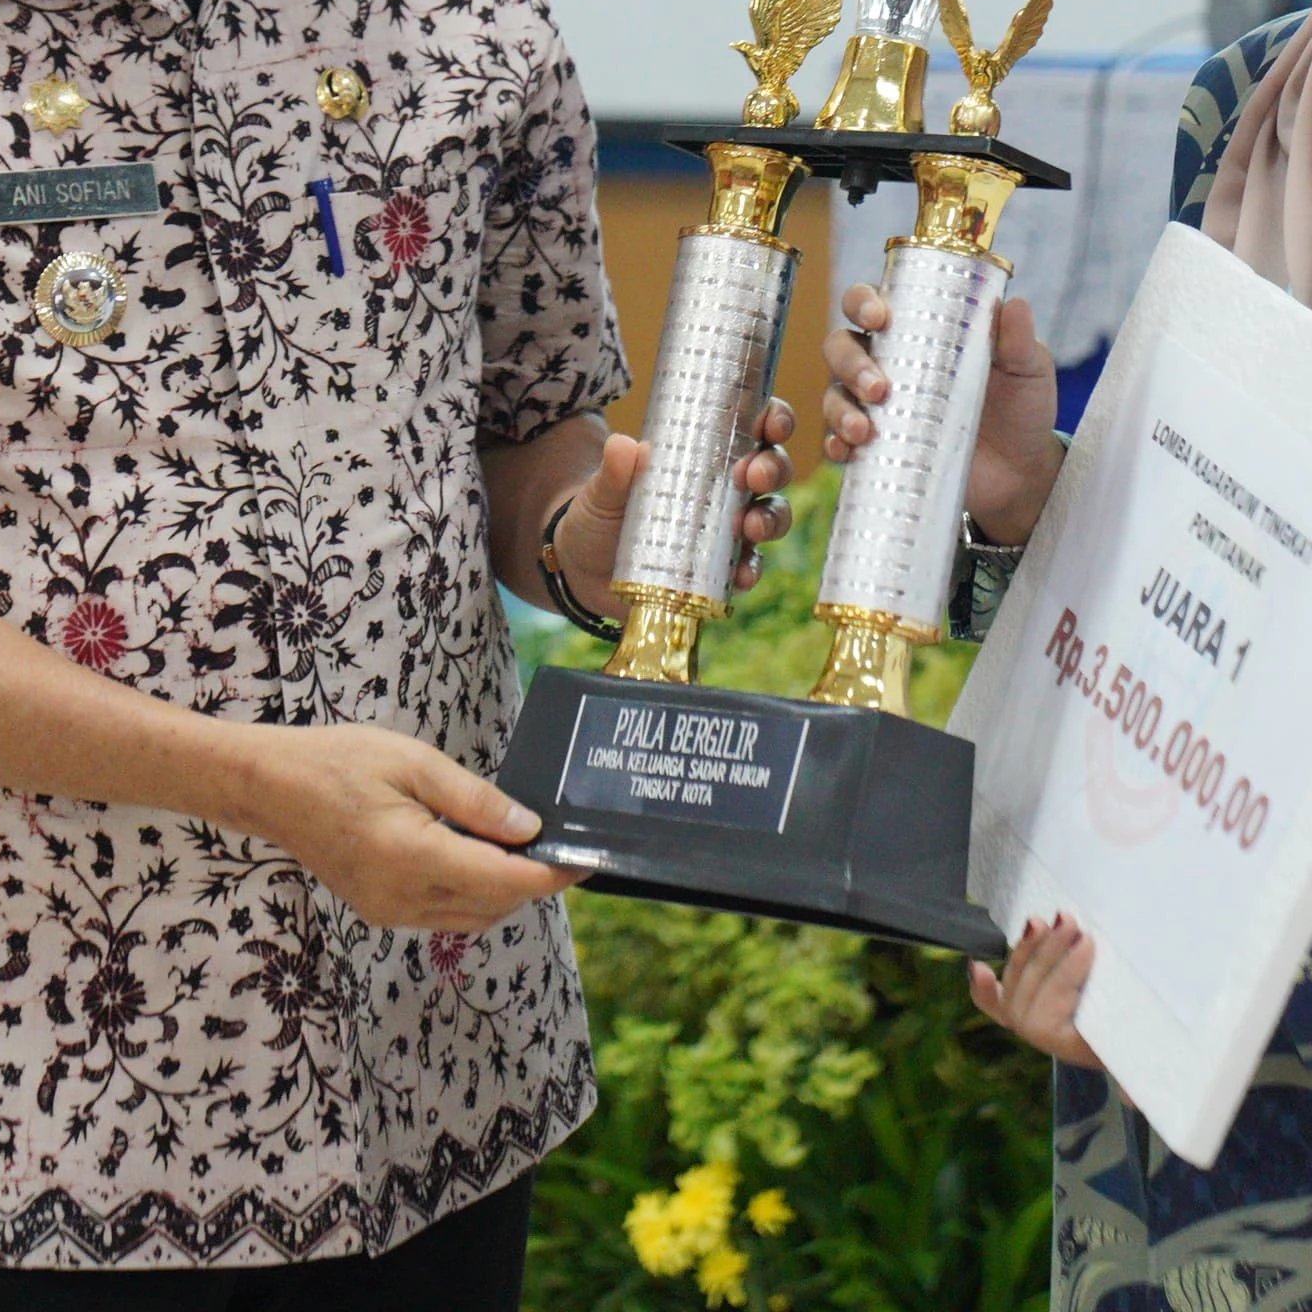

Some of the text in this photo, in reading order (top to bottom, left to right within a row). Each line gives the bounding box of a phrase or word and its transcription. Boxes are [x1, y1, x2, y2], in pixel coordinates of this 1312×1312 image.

[11, 177, 132, 206] ANI SOFIAN
[1151, 419, 1193, 474] LOMBA
[1191, 455, 1261, 521] KADARKUM
[1188, 512, 1268, 588] PONTIANAK
[1140, 567, 1251, 684] JUARA 1
[612, 707, 760, 762] PIALA BERGILIR
[1045, 607, 1271, 852] Rp.3.500.000,00
[587, 746, 770, 788] LOMBA KELUARGA SADAR HUKUM
[630, 776, 712, 806] TINGKAT KOTA
